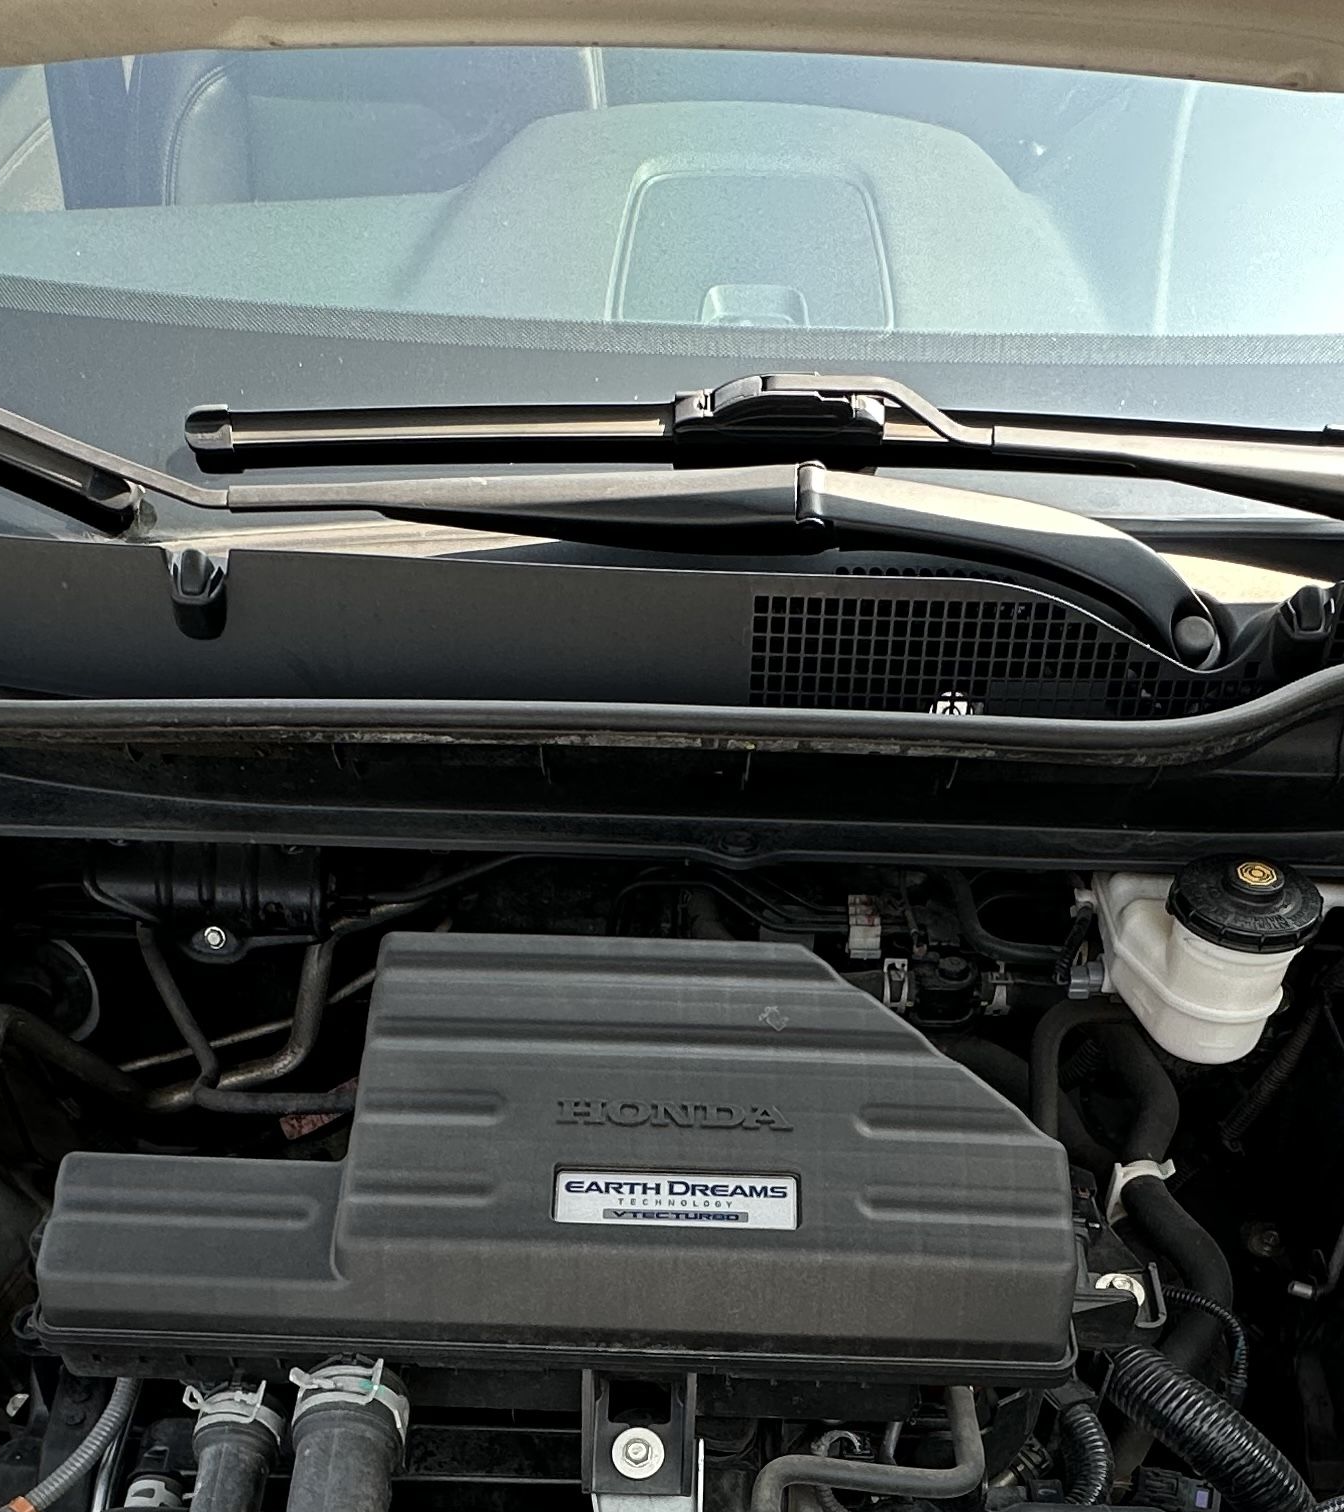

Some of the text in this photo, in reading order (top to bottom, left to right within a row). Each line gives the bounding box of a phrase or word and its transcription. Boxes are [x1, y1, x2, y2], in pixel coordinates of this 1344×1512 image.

[556, 1101, 793, 1131] HONDA
[565, 1180, 787, 1198] EARTH DREAMS
[618, 1198, 733, 1208] TECHNOLOGY
